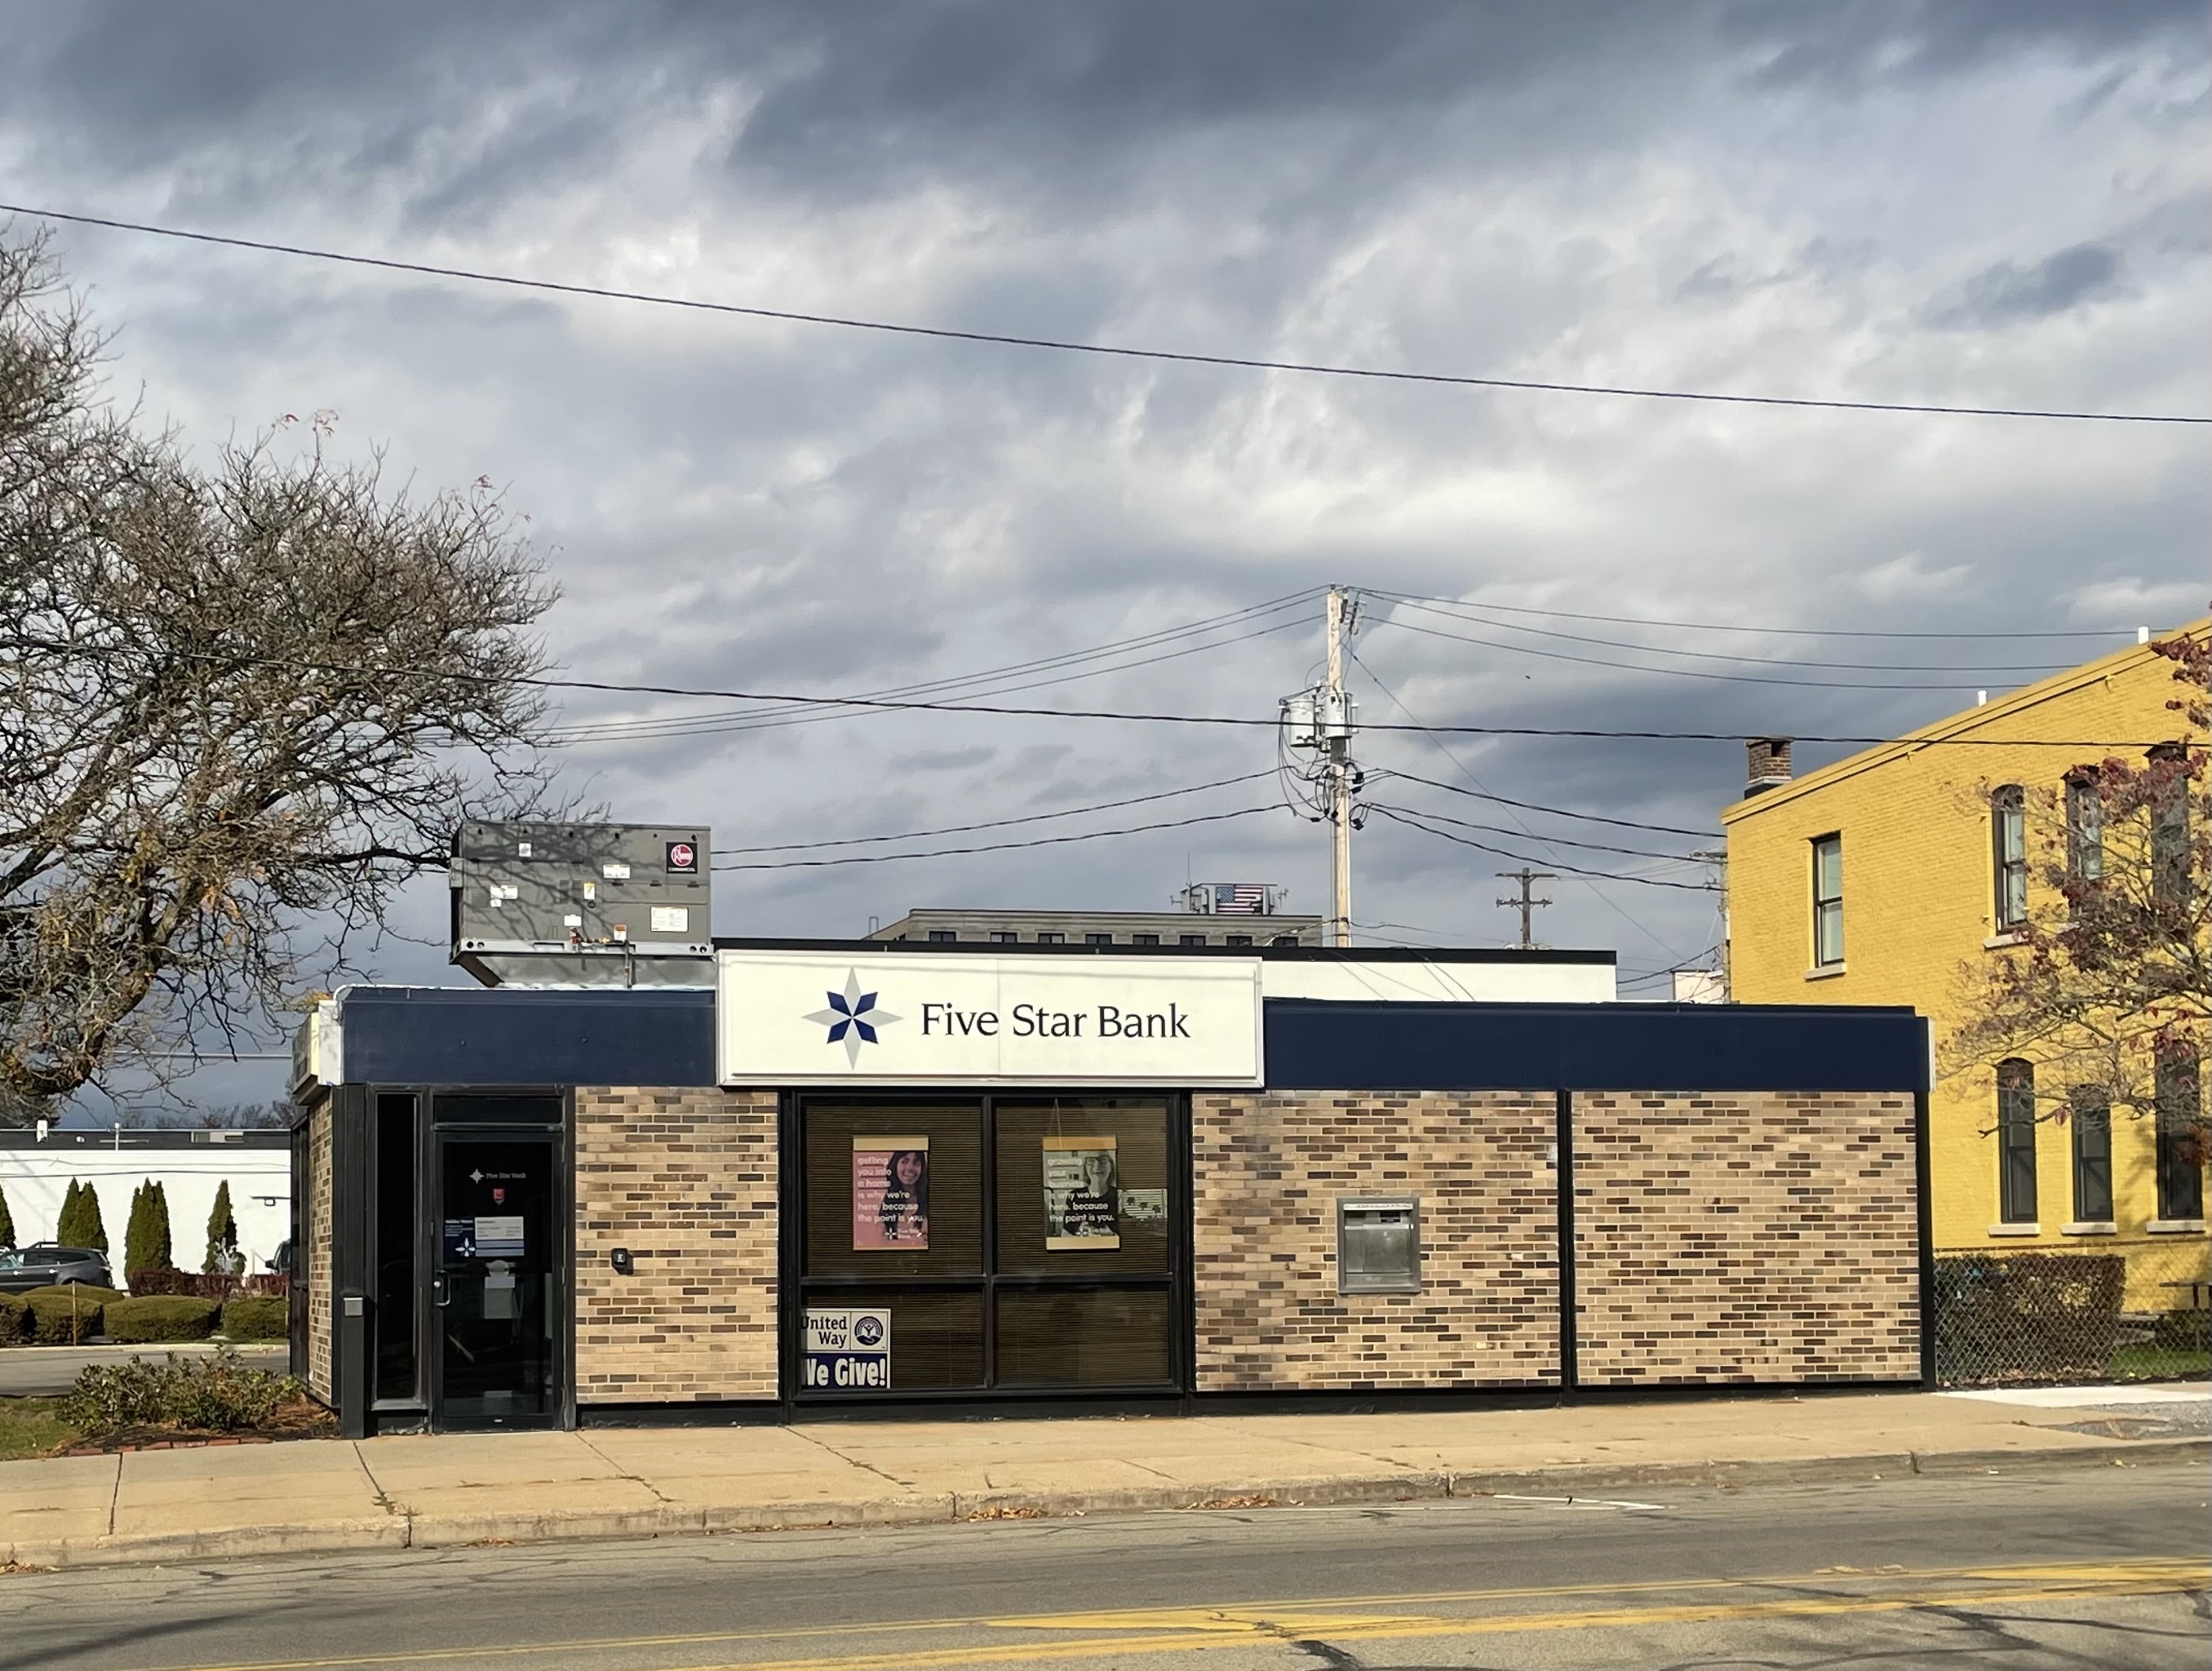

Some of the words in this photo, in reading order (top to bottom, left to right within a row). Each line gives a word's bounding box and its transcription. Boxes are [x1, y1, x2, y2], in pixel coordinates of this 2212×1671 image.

[921, 1002, 999, 1036] Five
[1013, 1004, 1087, 1037] Star
[1097, 1002, 1191, 1038] Bank
[858, 1168, 873, 1177] you
[887, 1190, 911, 1199] we're
[883, 1203, 919, 1211] because
[1072, 1202, 1109, 1211] because
[875, 1214, 897, 1224] point
[898, 1213, 906, 1222] is
[1065, 1213, 1087, 1225] point
[1088, 1213, 1095, 1221] is
[801, 1315, 848, 1330] United
[818, 1332, 848, 1349] Way
[835, 1357, 886, 1386] Give!
